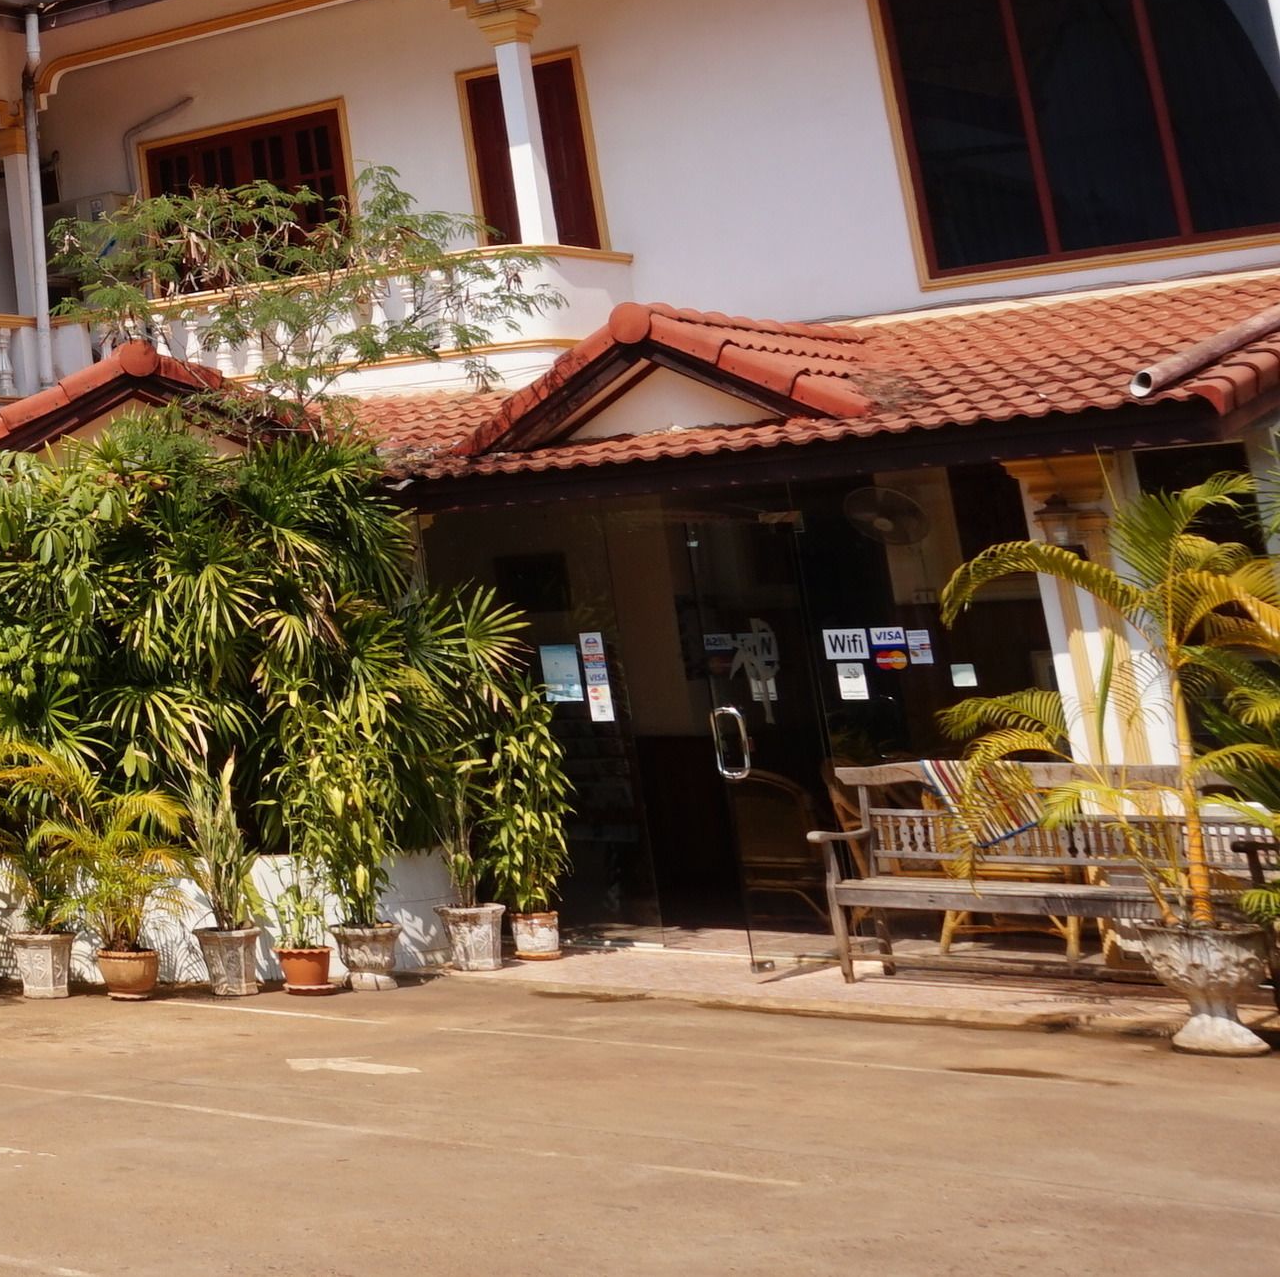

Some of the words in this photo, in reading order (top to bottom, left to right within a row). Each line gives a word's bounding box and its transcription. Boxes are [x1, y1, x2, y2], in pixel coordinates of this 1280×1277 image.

[875, 630, 903, 641] VISA
[827, 633, 864, 654] Wifi
[589, 673, 607, 683] VISA
